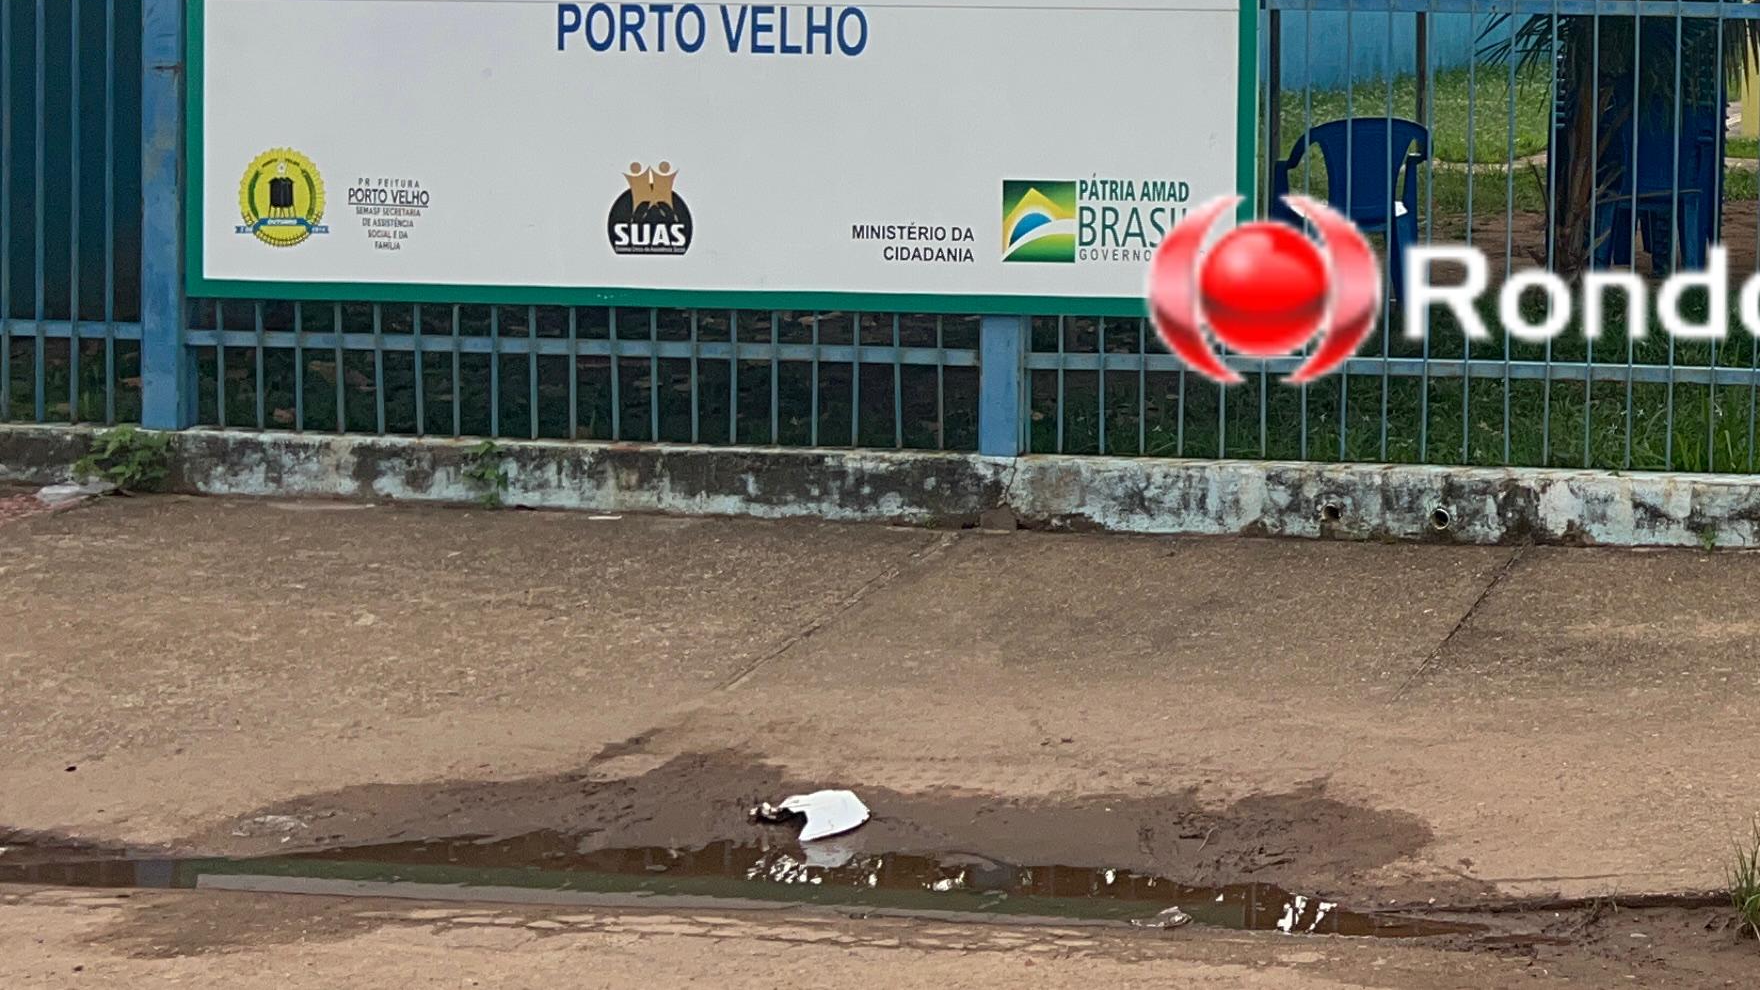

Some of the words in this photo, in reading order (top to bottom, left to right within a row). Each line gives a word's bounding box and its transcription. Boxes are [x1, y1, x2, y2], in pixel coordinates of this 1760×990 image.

[557, 3, 706, 54] PORTO
[719, 4, 868, 57] VELHO
[358, 177, 420, 189] PRFEITURA
[1079, 172, 1136, 201] PÁTRIA
[1140, 180, 1190, 202] AMAD
[348, 187, 387, 204] PORTO
[391, 189, 430, 205] VELHO
[362, 217, 371, 227] DE
[852, 221, 947, 242] MINISTÉRIO
[951, 226, 975, 242] DA
[1078, 205, 1188, 248] BRASI
[614, 223, 686, 246] SUAS
[883, 245, 975, 263] CIDADANIA
